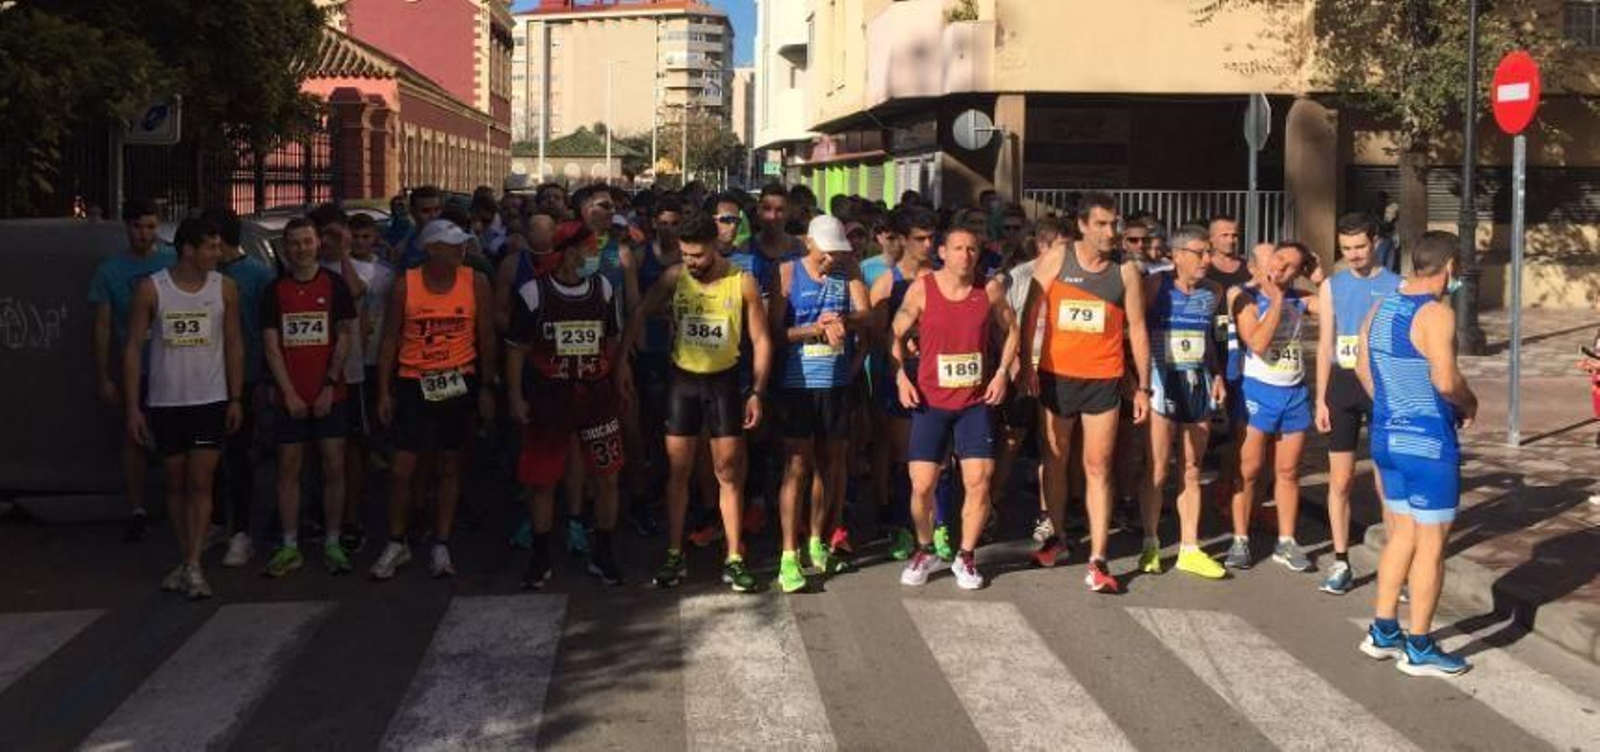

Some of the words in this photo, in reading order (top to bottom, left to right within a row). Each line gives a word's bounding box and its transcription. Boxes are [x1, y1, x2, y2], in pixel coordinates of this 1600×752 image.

[1069, 308, 1094, 321] 79
[173, 320, 200, 334] 93
[286, 320, 324, 335] 374
[687, 324, 723, 338] 384
[561, 329, 596, 344] 239
[1181, 339, 1191, 351] 9
[943, 362, 979, 377] 189
[426, 372, 457, 392] 381
[580, 417, 620, 440] CHICAG
